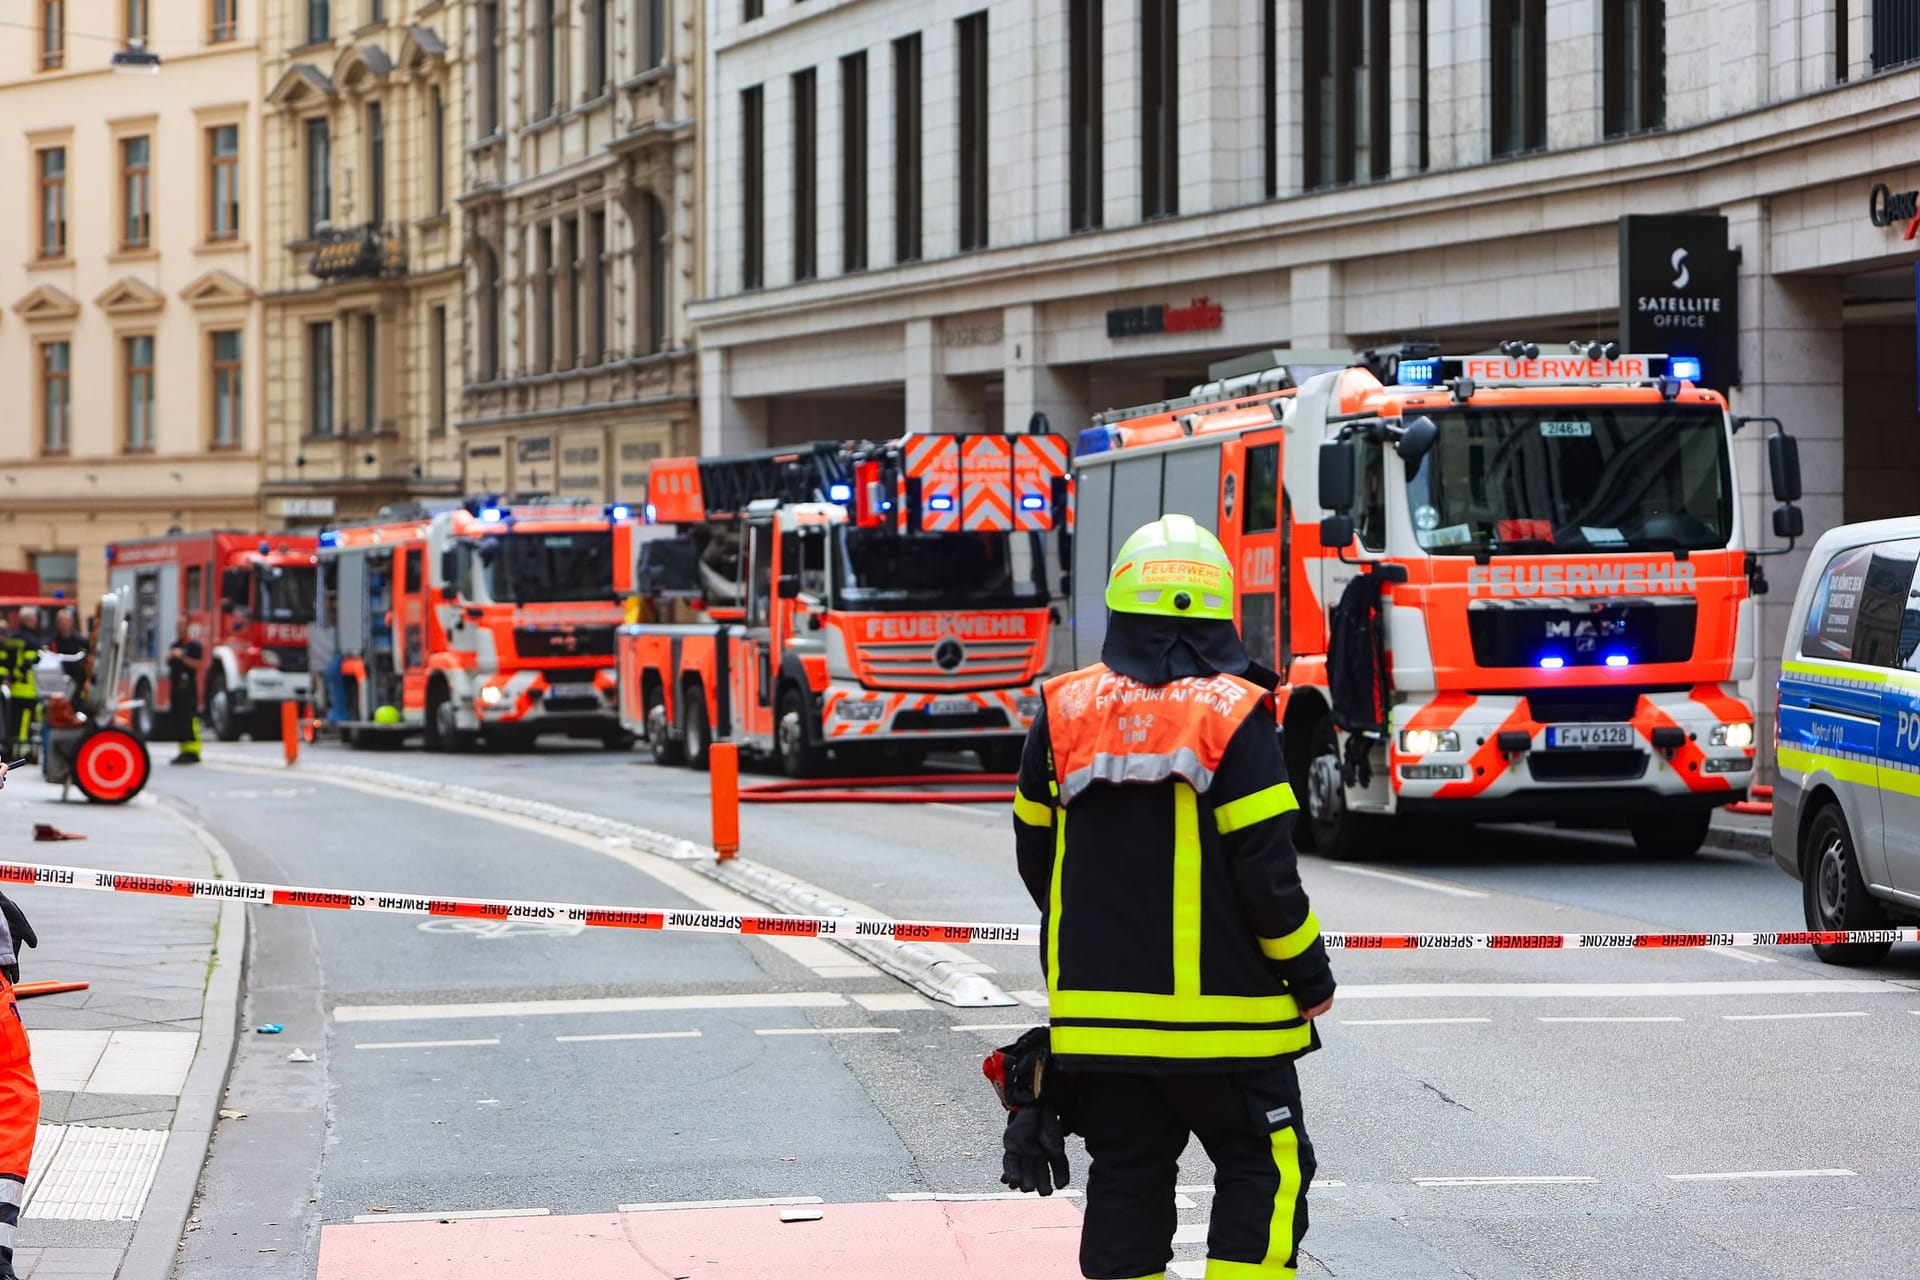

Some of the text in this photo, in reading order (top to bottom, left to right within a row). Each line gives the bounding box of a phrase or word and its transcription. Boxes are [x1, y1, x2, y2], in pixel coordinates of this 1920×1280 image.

[1638, 297, 1720, 312] SATELLITE
[1653, 314, 1705, 327] OFFICE
[1468, 359, 1643, 379] FEUERWEHR
[1547, 423, 1585, 434] 2/46-1
[1142, 560, 1221, 578] FEUERWEHR
[1467, 562, 1697, 596] FEUERWEHR
[866, 616, 1026, 638] FEUERWEHR
[1546, 621, 1626, 637] MAN
[1195, 692, 1232, 717] MAIN
[1592, 727, 1626, 742] 6128
[1812, 721, 1844, 744] Notruf 110
[0, 864, 74, 884] FEUERWEH
[96, 872, 265, 900] FEUERWEHR SPERRZONE
[288, 890, 457, 913] FEUERWEHR SPERRZONE
[480, 903, 647, 925] FEUERWEHR SPERRZONE
[669, 912, 837, 934] FEUERWEHR SPERRZONE
[856, 920, 1019, 941] FEUERWEHR SPERRZONE
[1579, 933, 1734, 947] FEUERWEHR SPERRZONE
[1752, 930, 1903, 945] FEUERWEHR SPERRZONE
[1403, 934, 1564, 949] FEUERWEHR SPERRZONE
